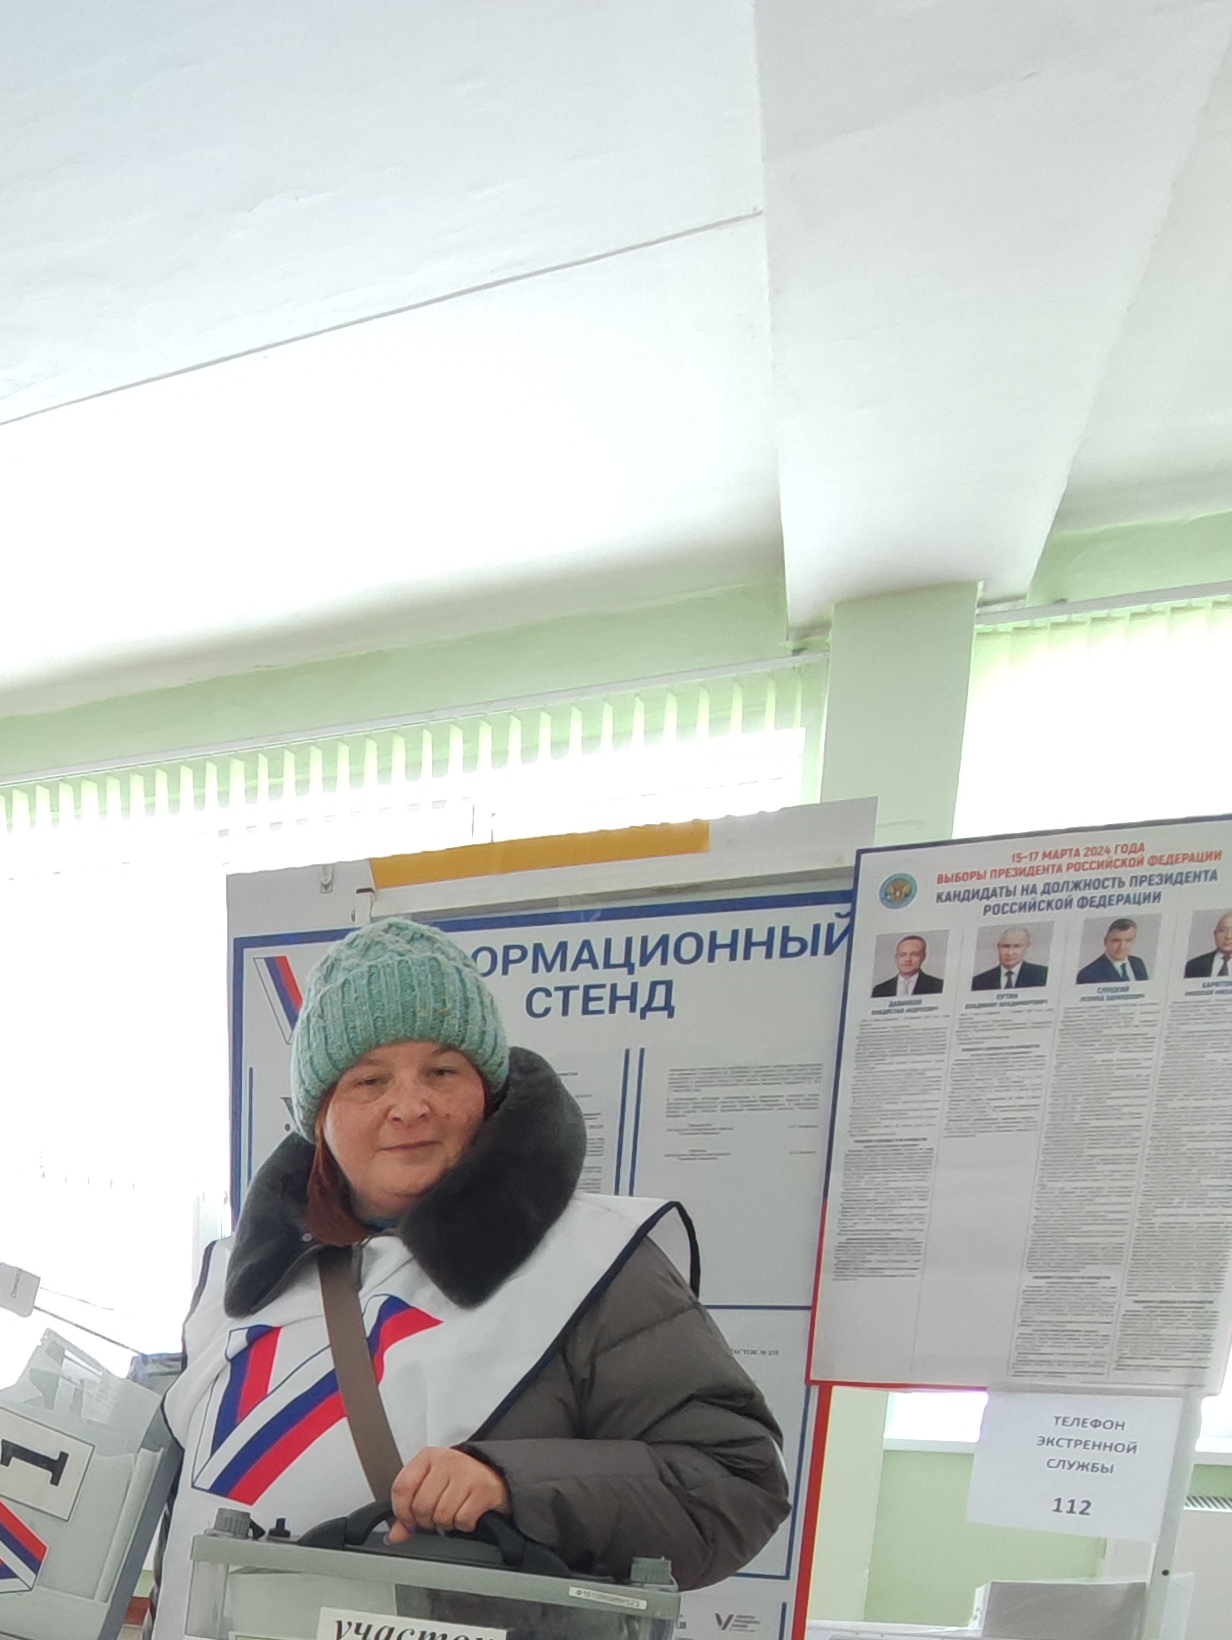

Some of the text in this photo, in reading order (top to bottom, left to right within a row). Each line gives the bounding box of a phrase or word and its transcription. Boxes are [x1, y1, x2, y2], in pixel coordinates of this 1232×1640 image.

[1041, 848, 1081, 861] МАРТА
[1083, 845, 1111, 858] 2024
[1114, 842, 1145, 856] ГОДА
[937, 850, 1223, 884] ВЫБОРЫ ПРЕЗИДЕНТА РОССИЙСКОЙ ФЕДЕРАЦИИ
[936, 869, 1218, 903] КАНДИДАТЫ НА ДОЛЖНОСТЬ ПРЕЗИДЕНТА
[983, 891, 1162, 916] РОССИЙСКОЙ ФЕДЕРАЦИИ
[471, 911, 851, 978] ОРМАЦИОННЫЙ
[525, 979, 676, 1021] СТЕНД
[1053, 1415, 1126, 1431] ТЕЛЕФОН
[1036, 1436, 1138, 1454] ЭКСТРЕННОЙ
[0, 1438, 69, 1486] 1
[1046, 1458, 1114, 1474] СЛУЖБЫ
[1052, 1497, 1092, 1516] 112
